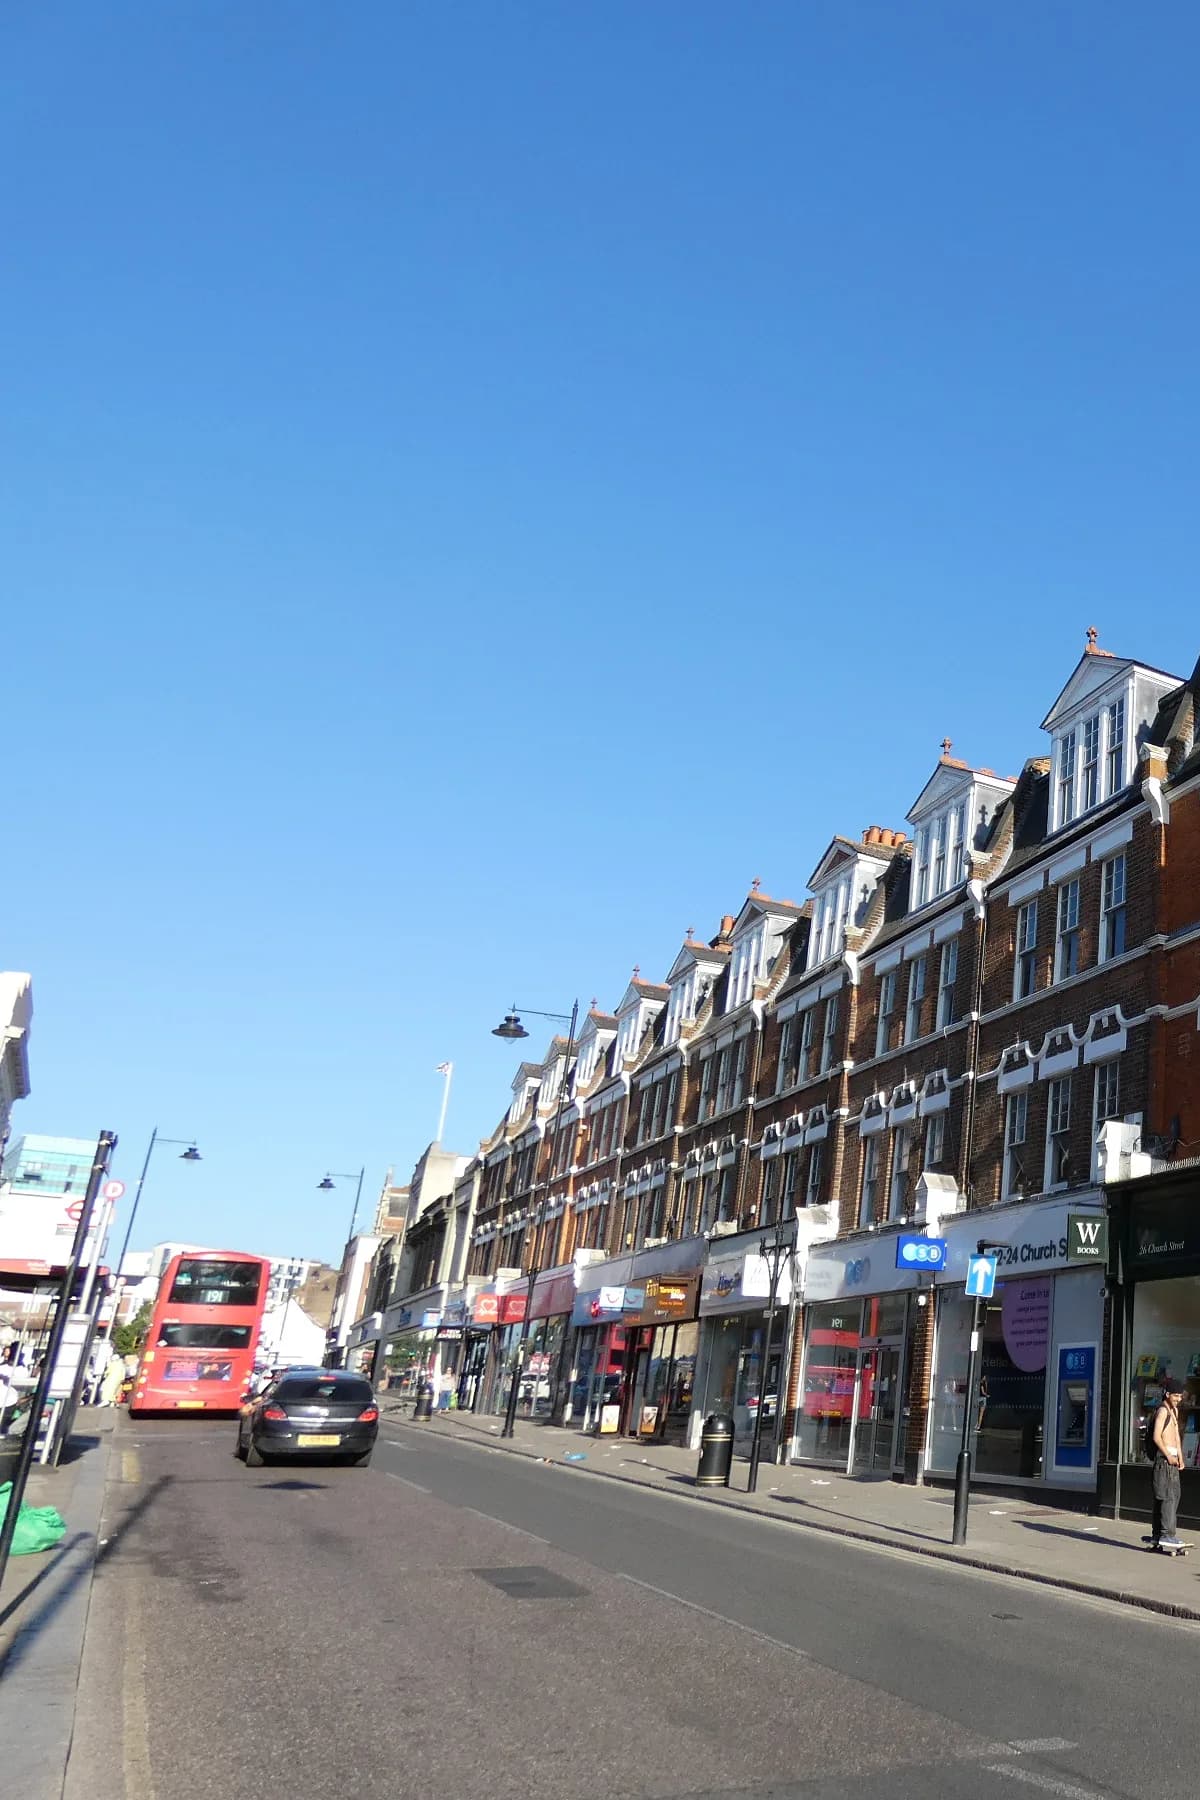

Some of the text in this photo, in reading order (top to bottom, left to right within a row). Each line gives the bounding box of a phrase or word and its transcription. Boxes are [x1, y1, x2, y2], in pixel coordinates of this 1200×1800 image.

[1075, 1222, 1101, 1245] W
[1020, 1241, 1058, 1263] Church
[1076, 1246, 1099, 1255] BOOKS
[207, 1290, 224, 1302] 191
